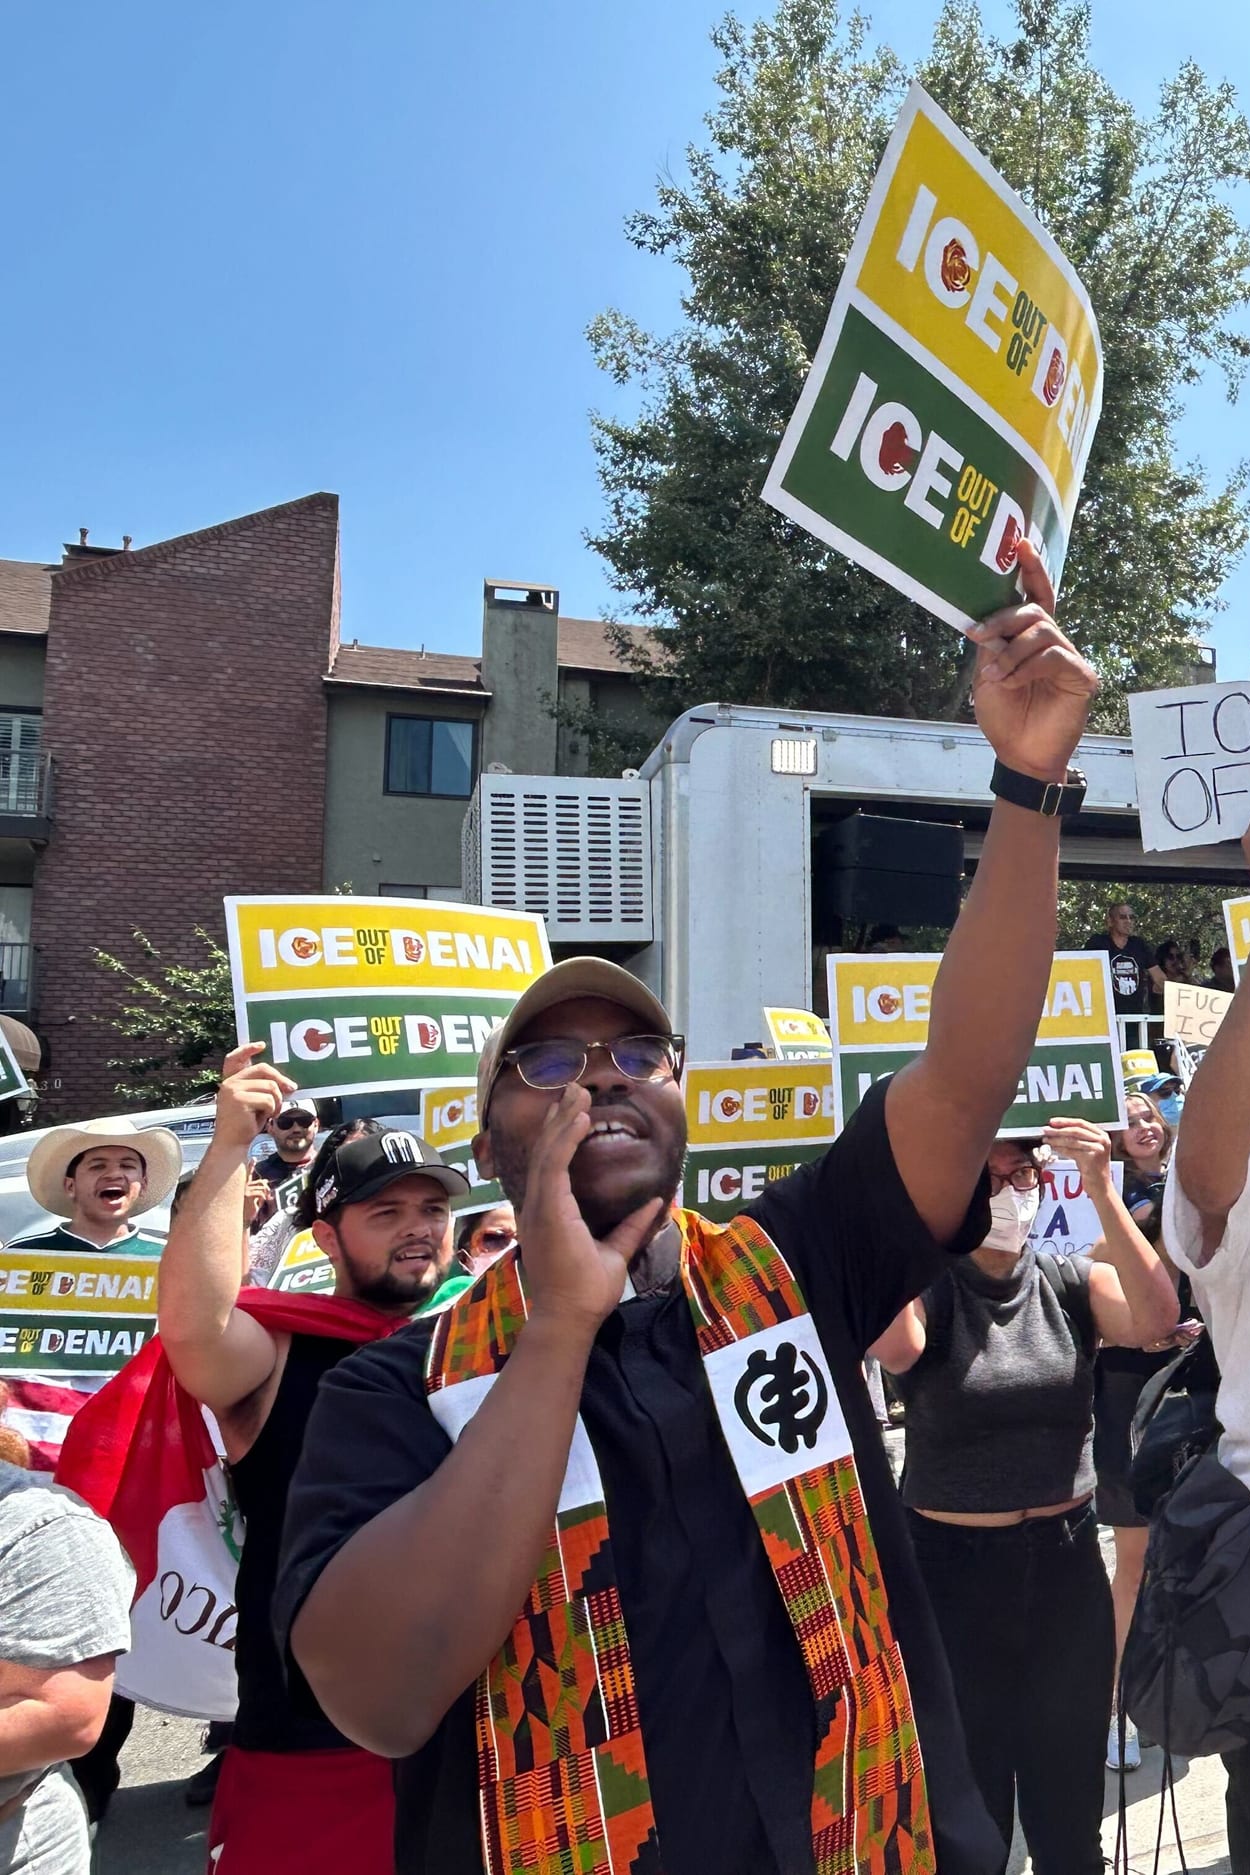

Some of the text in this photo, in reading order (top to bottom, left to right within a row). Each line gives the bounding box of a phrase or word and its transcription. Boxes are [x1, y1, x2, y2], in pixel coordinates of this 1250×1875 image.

[896, 183, 1020, 353] ICE
[1012, 291, 1047, 349] OUT
[1005, 327, 1032, 377] OF
[830, 371, 964, 530] ICE
[957, 464, 998, 506] OUT
[950, 510, 981, 549] OF
[259, 927, 533, 974] ICE OUT OF DENA!
[852, 984, 931, 1023] ICE
[1177, 988, 1223, 1015] FUC
[270, 1017, 372, 1064] ICE
[370, 1016, 402, 1036] OUT
[379, 1035, 400, 1055] OF
[698, 1087, 768, 1124] ICE
[769, 1087, 794, 1104] OUT
[773, 1104, 789, 1121] OF
[698, 1165, 766, 1203] ICE
[51, 1271, 155, 1300] DENA!
[39, 1329, 146, 1356] DENA!
